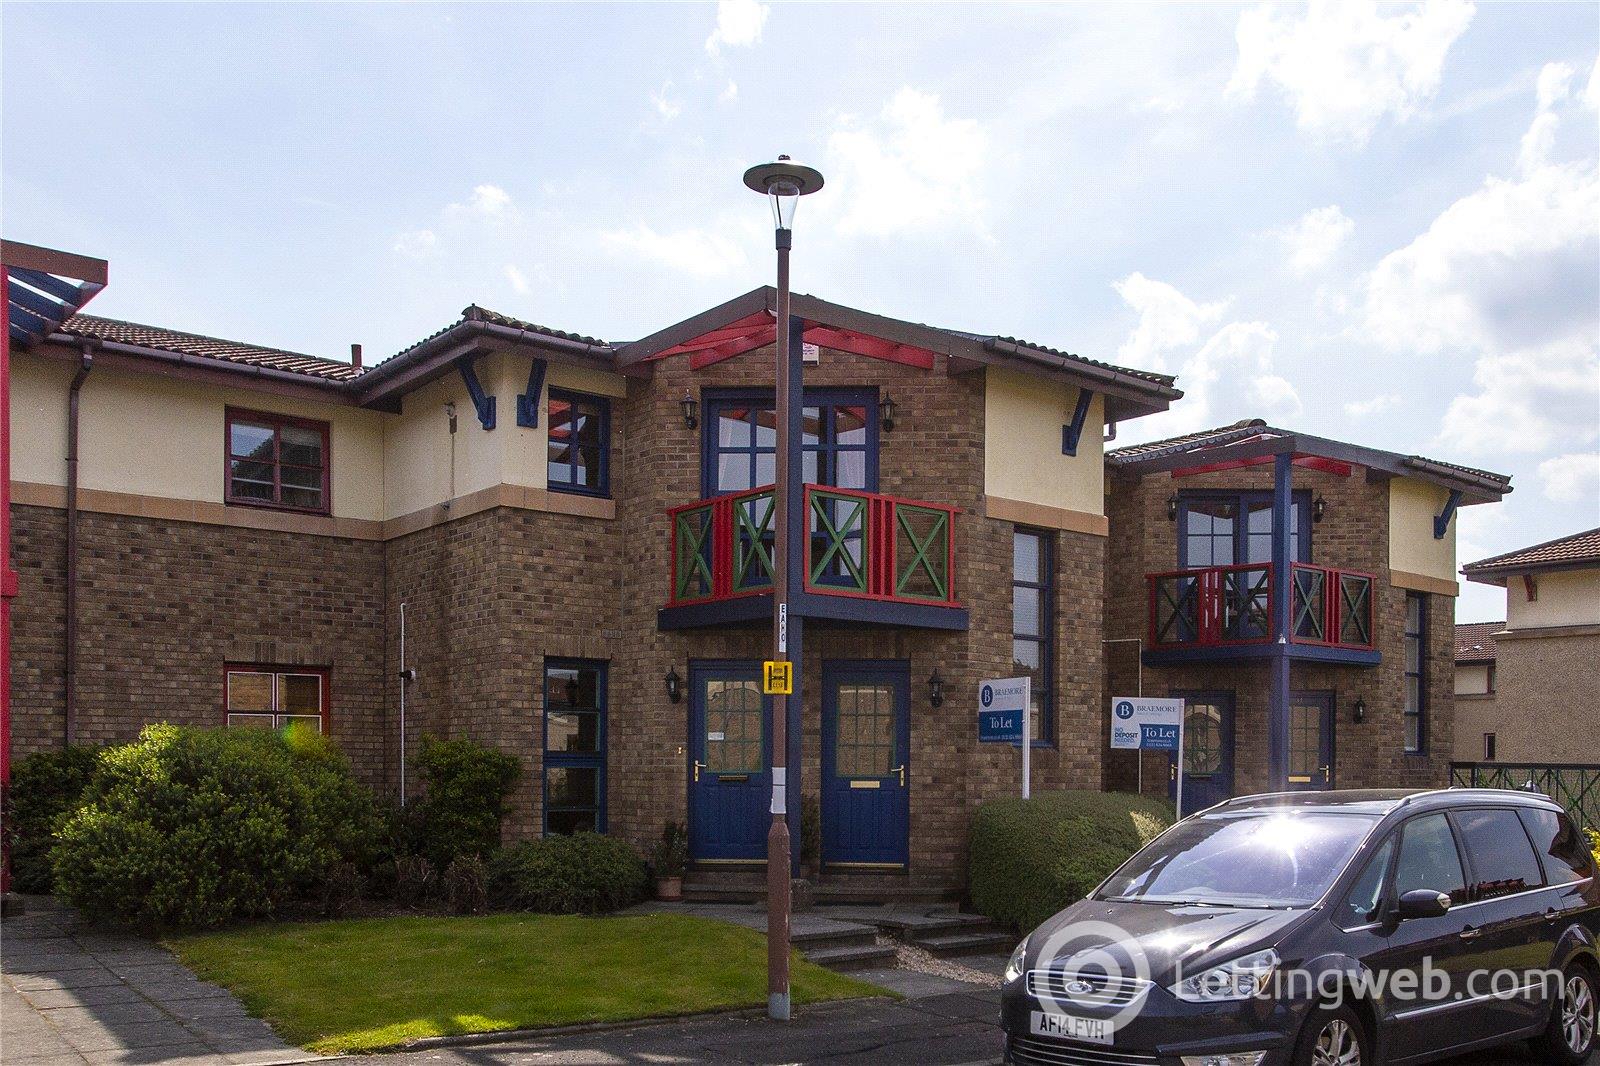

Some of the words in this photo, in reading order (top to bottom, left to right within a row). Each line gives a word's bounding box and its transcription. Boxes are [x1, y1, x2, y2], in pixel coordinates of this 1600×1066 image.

[984, 689, 991, 703] B
[1120, 704, 1130, 716] B
[1136, 705, 1178, 713] BRAEMORE
[990, 717, 1000, 729] To
[1000, 716, 1013, 729] Let
[1143, 727, 1157, 737] To
[1159, 727, 1175, 738] Let
[1039, 1013, 1071, 1035] AF14
[1075, 1018, 1104, 1040] FVH
